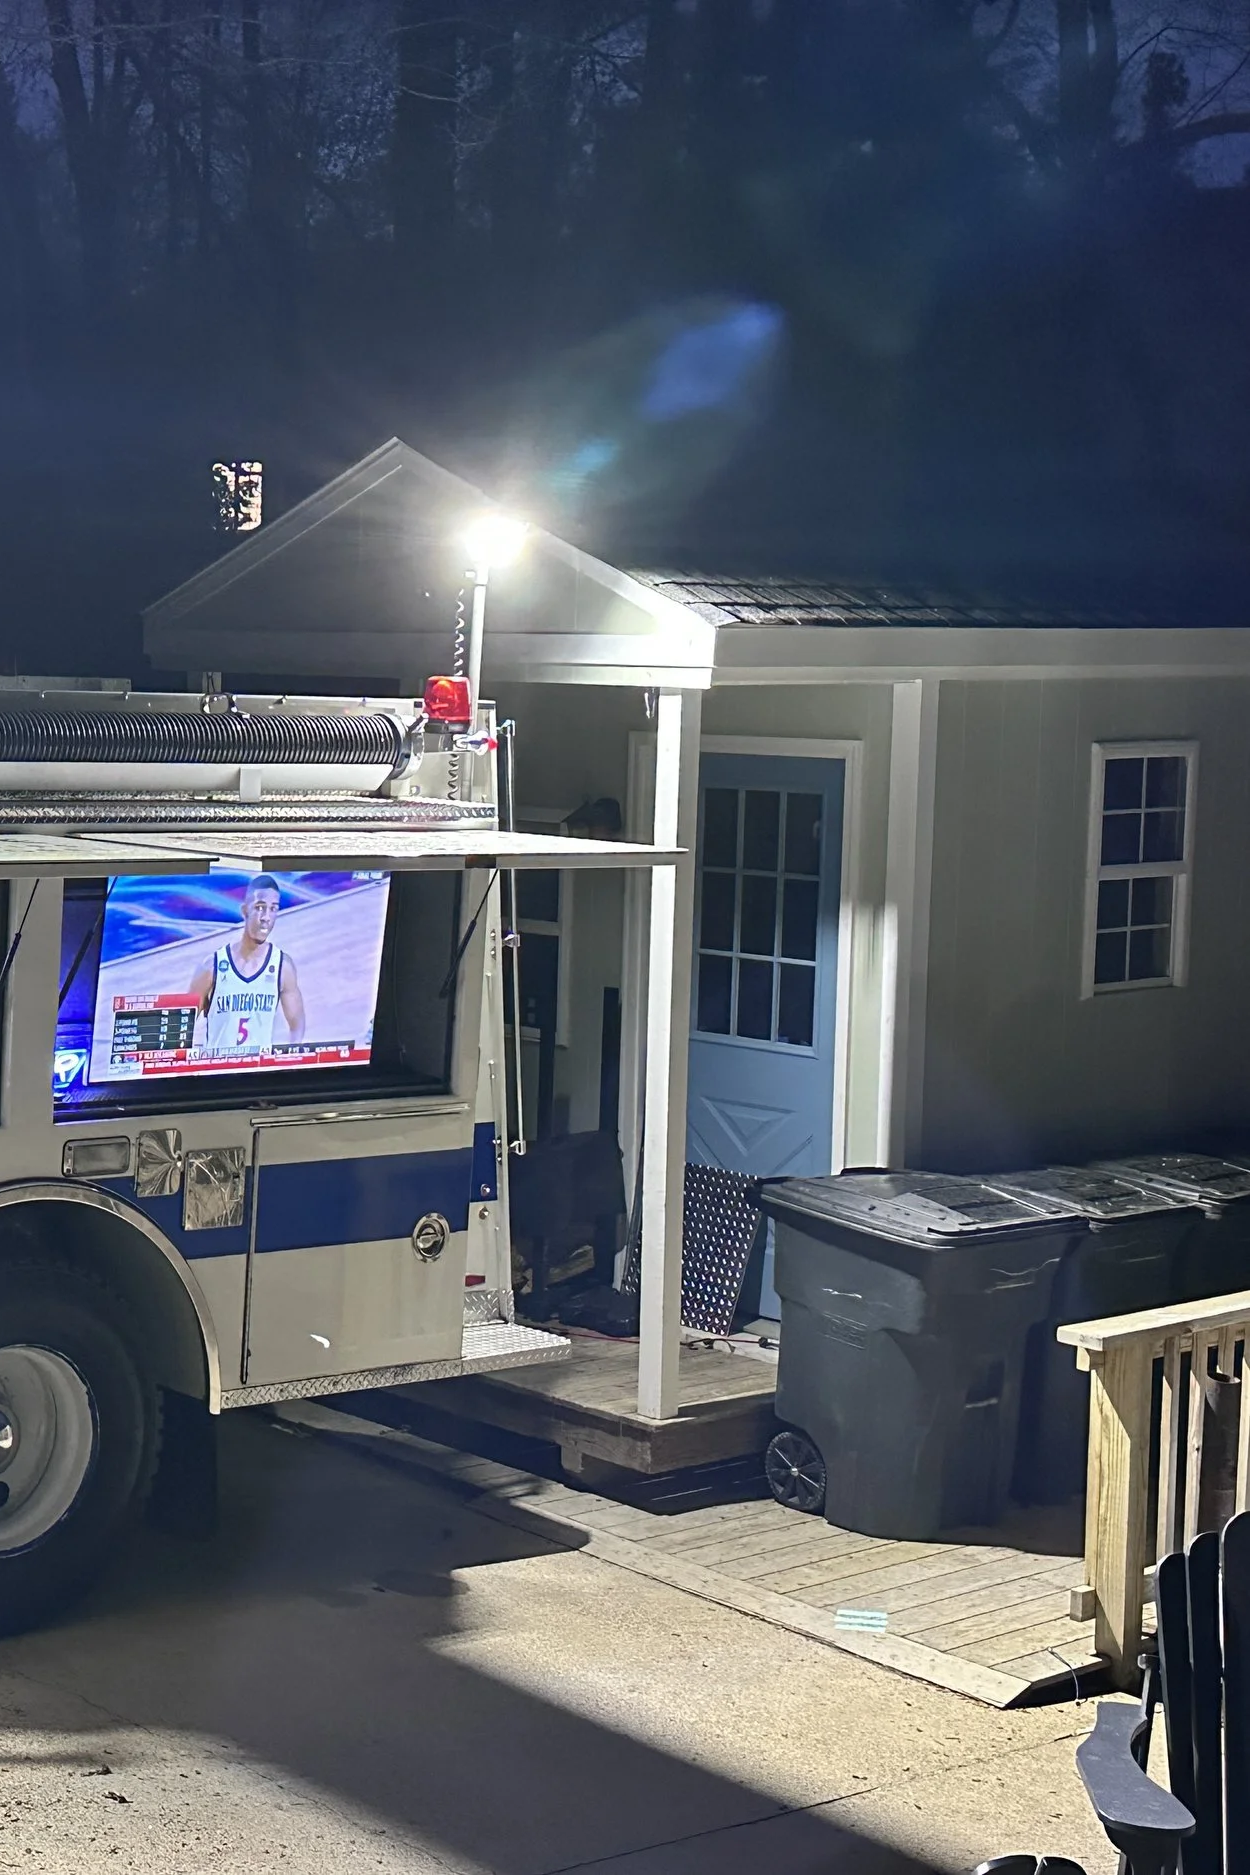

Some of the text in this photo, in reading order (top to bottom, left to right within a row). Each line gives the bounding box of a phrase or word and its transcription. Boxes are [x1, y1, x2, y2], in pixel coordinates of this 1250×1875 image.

[217, 993, 275, 1013] SAN DIEGO STATE
[236, 1017, 250, 1046] 5
